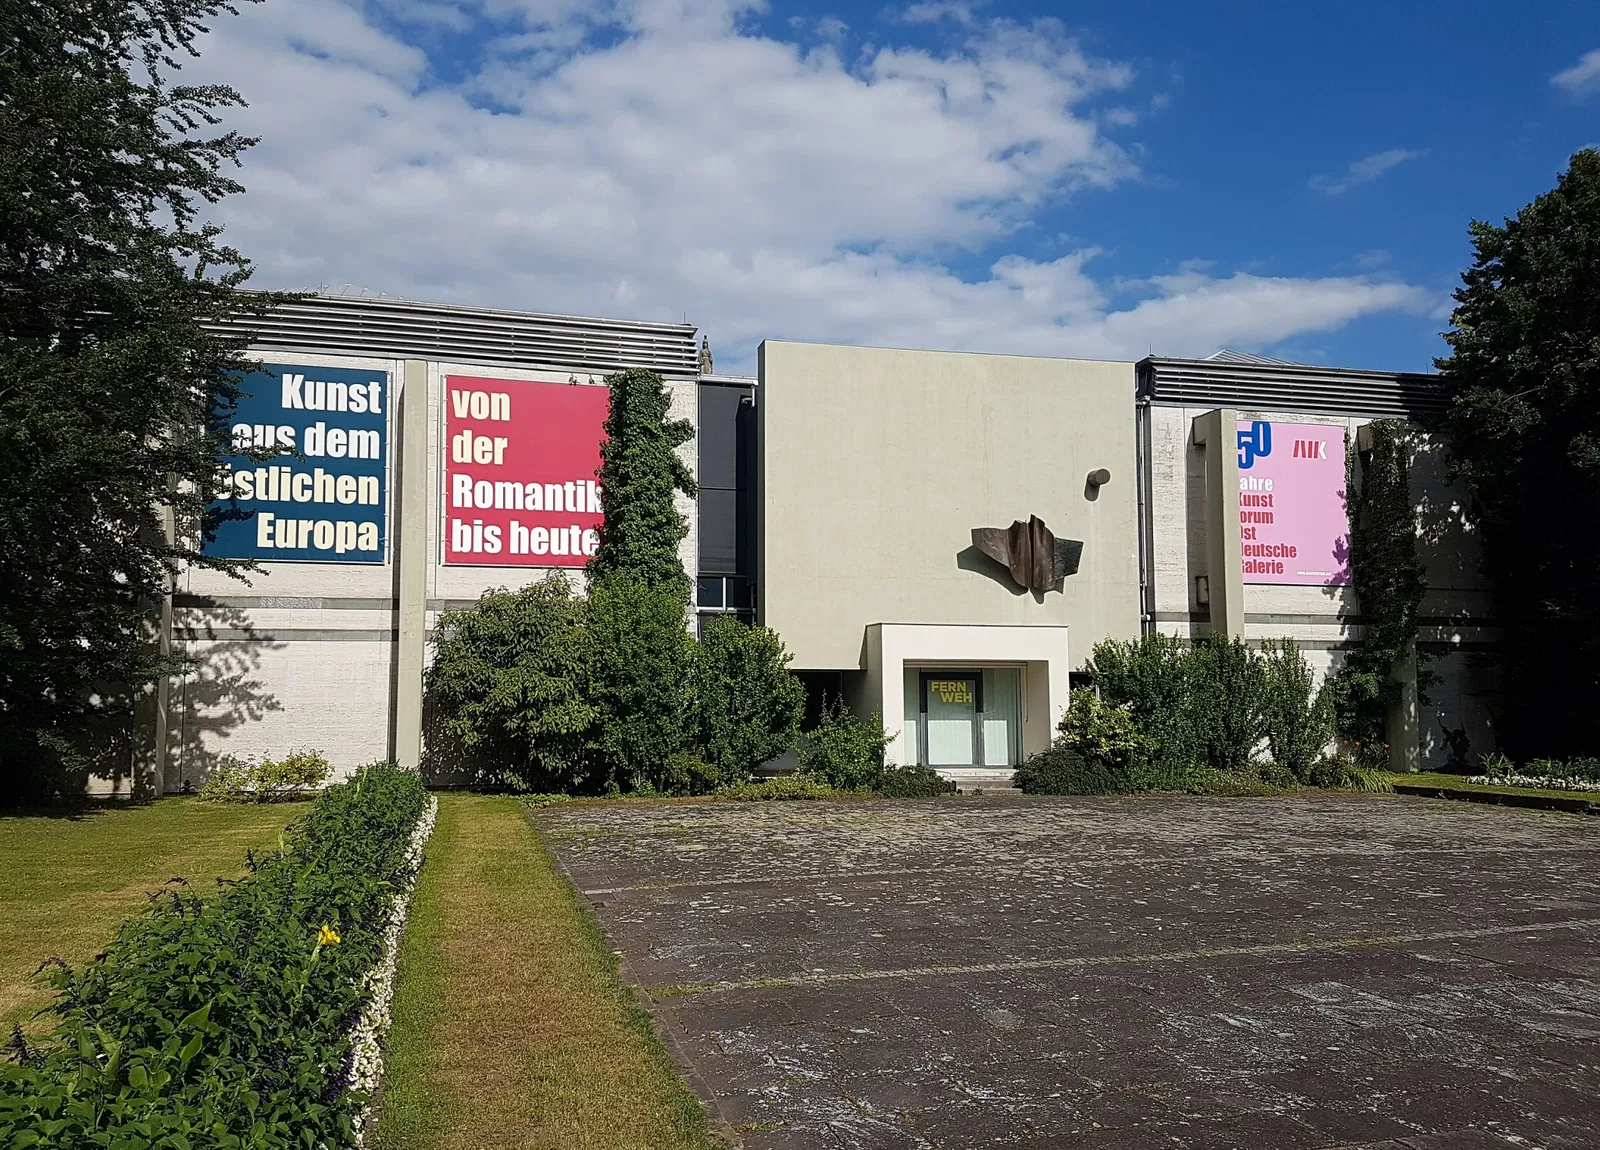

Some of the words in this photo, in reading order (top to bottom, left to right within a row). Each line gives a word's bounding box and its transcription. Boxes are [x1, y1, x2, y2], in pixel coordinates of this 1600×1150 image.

[281, 373, 382, 414] Kunst
[451, 389, 511, 421] von
[231, 423, 296, 455] aus
[303, 421, 380, 460] dem
[452, 429, 508, 465] der
[1237, 421, 1272, 470] 50
[452, 473, 605, 514] Romantik
[1239, 475, 1274, 492] ahre
[257, 512, 379, 554] Europa
[1240, 511, 1274, 524] orum
[452, 518, 502, 553] bis
[509, 520, 601, 556] heute
[1241, 542, 1297, 558] eutsche
[1242, 559, 1284, 575] alerie
[931, 681, 967, 692] FERN
[940, 692, 973, 703] WEH
